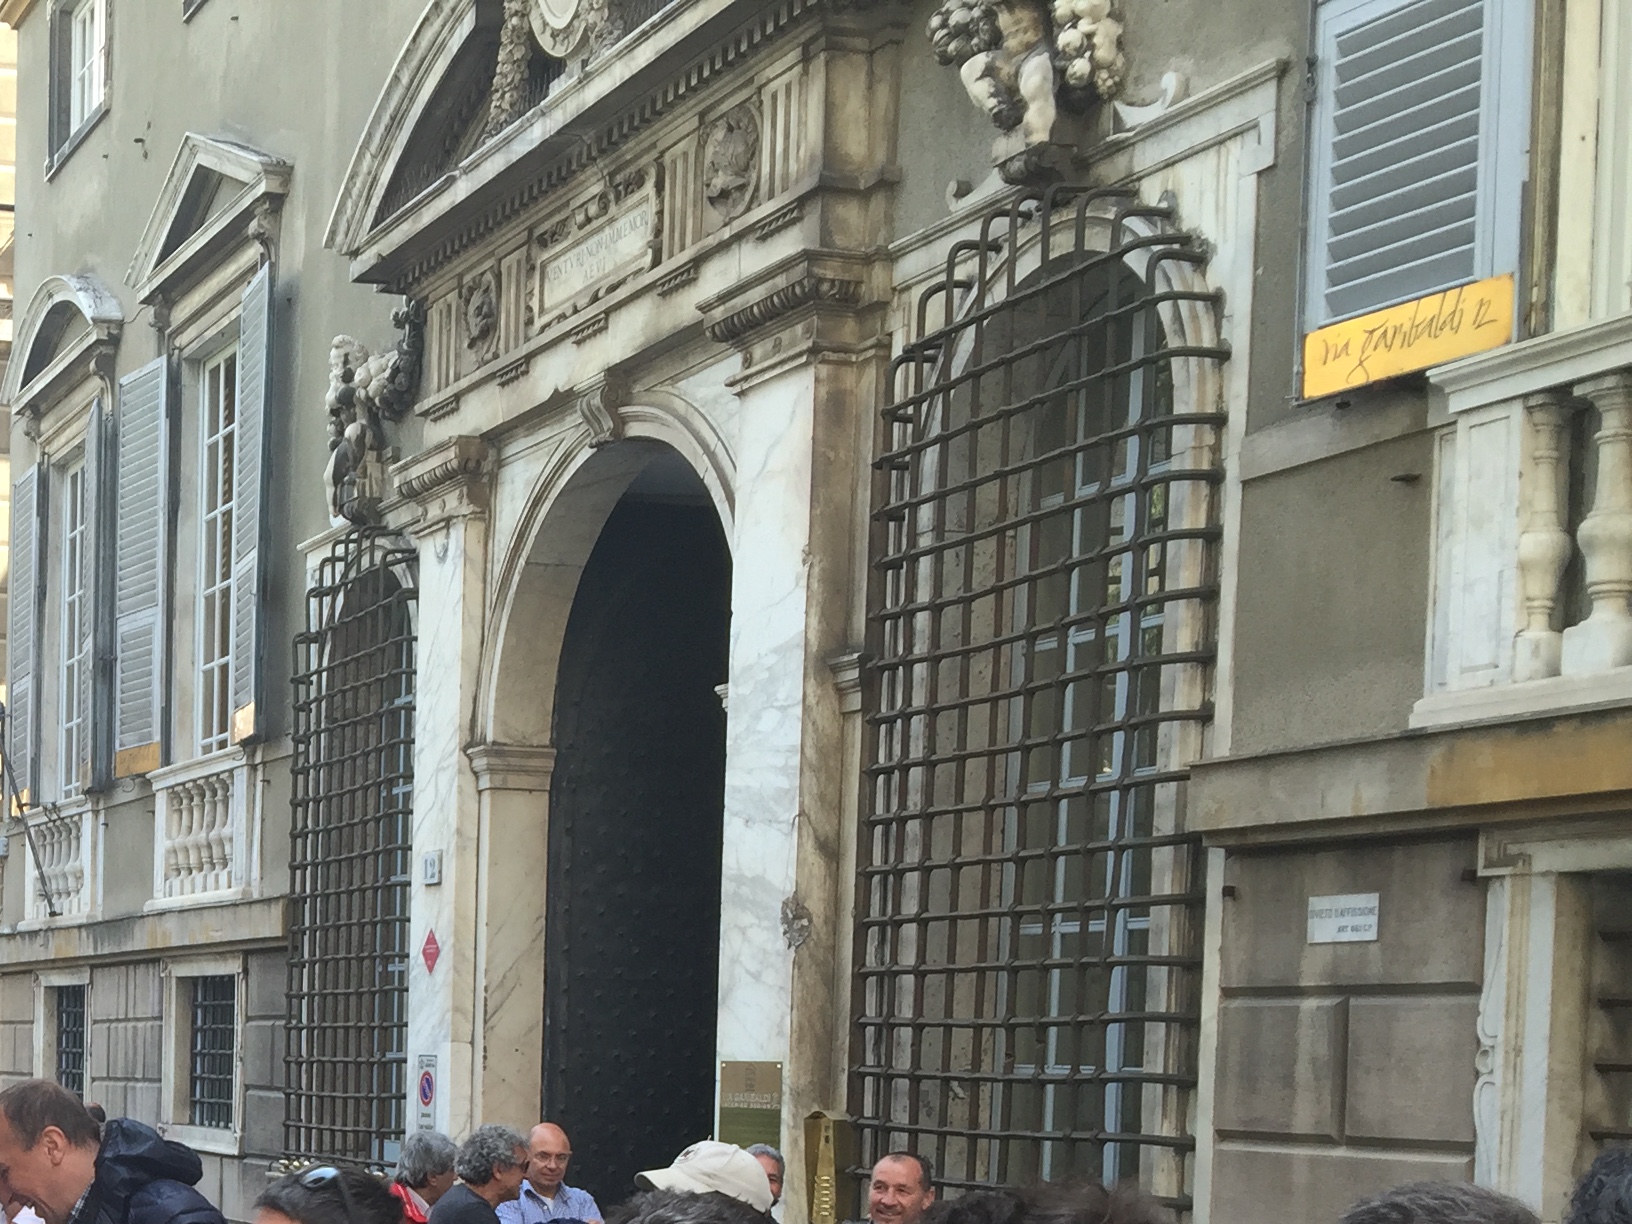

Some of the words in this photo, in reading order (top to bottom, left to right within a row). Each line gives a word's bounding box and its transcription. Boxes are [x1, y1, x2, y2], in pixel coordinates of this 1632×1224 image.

[1346, 286, 1466, 384] garibaldi
[1472, 297, 1498, 330] 12
[423, 857, 436, 880] 12
